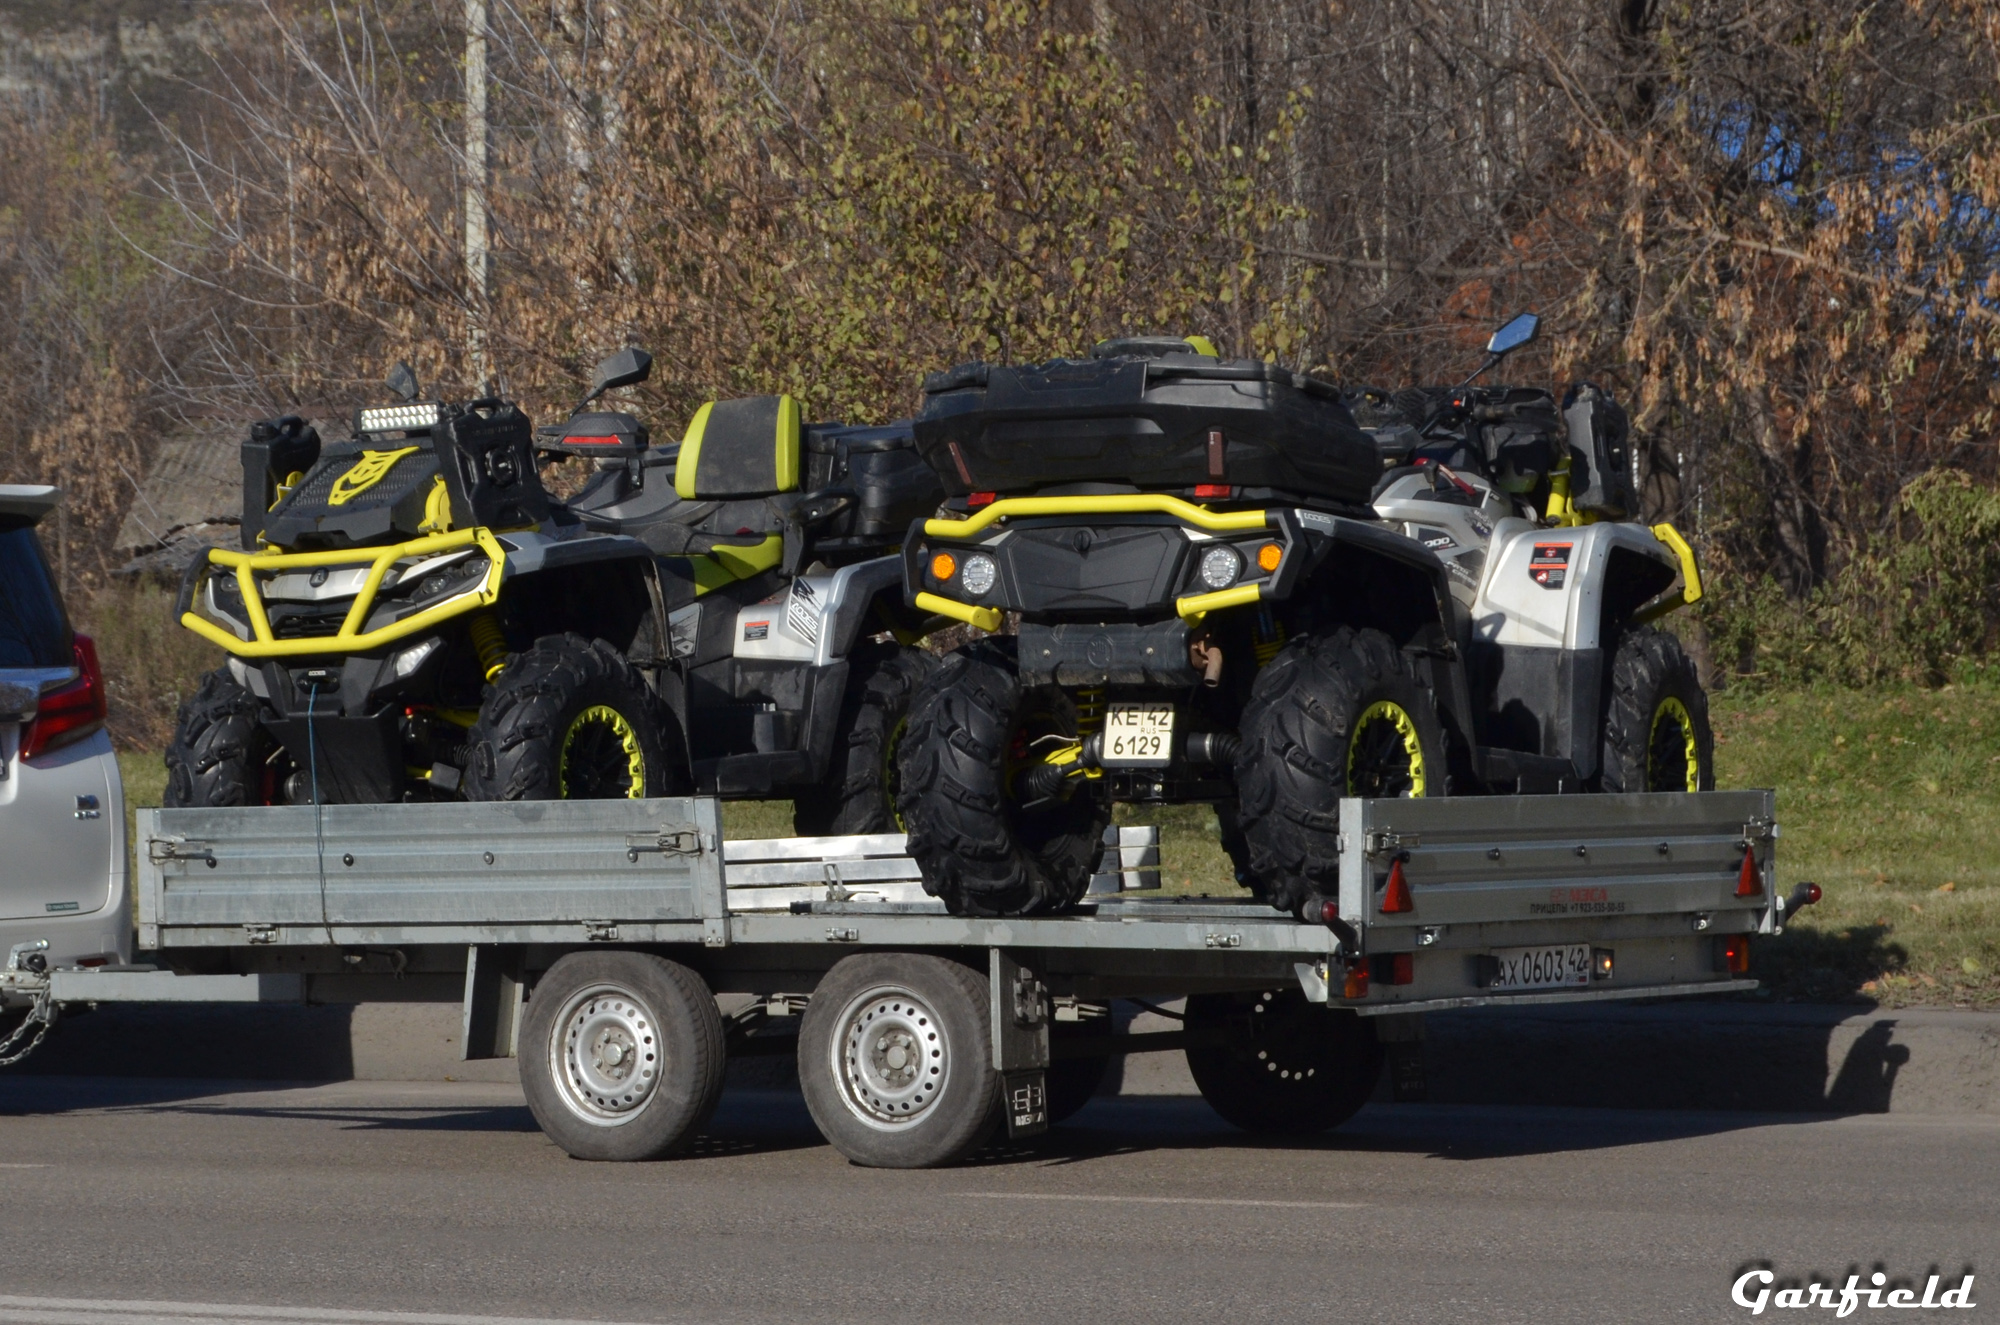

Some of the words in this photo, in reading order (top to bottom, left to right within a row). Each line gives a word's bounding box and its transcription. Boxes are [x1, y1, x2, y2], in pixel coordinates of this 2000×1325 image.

[1111, 706, 1139, 726] КЕ
[1147, 706, 1170, 726] 42
[1141, 727, 1157, 735] RUS
[1113, 735, 1160, 755] 6129
[1522, 950, 1564, 984] 0603
[1568, 947, 1584, 972] 42
